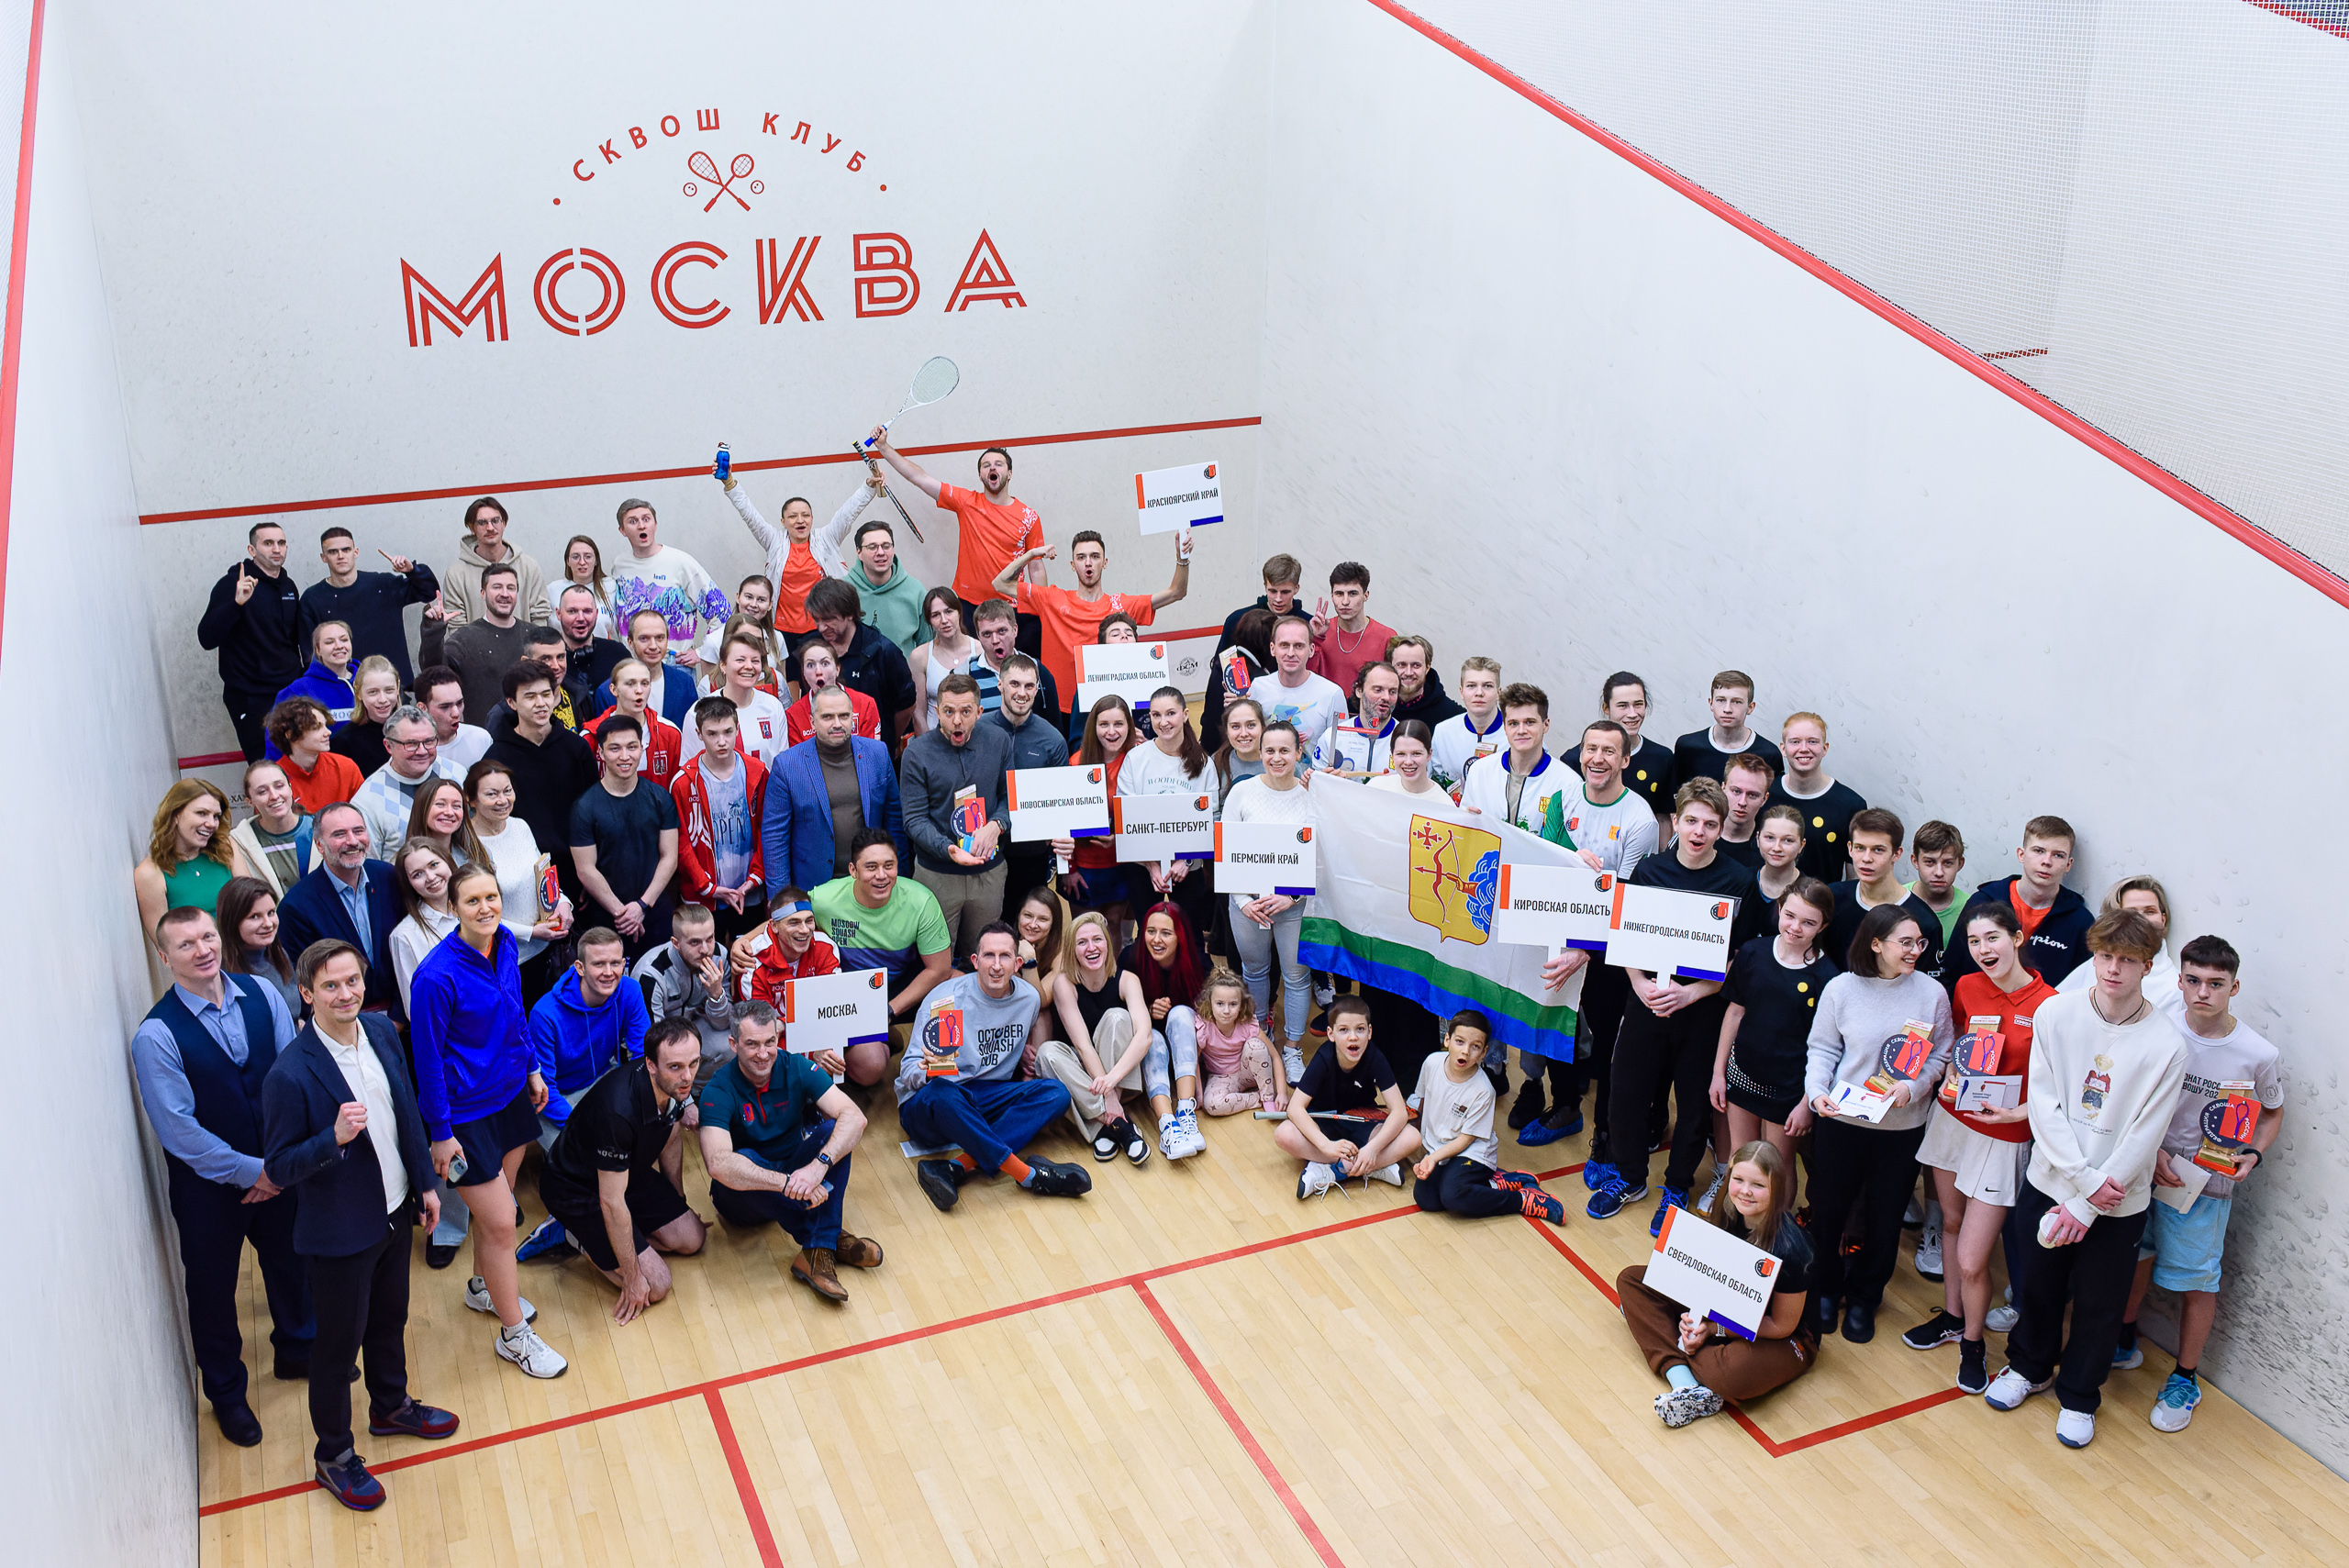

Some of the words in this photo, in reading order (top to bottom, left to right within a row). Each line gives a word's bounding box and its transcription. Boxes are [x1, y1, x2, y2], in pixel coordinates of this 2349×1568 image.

[573, 108, 721, 183] СКВОШ
[762, 111, 867, 174] КЛУБ
[400, 228, 1029, 348] МОСКВА
[1147, 491, 1200, 508] КРАСНОЯРСКИЙ
[1200, 487, 1219, 500] КРАЙ
[1087, 673, 1139, 683] ЛЕНИНГРАДСКАЯ
[1139, 671, 1166, 681] ОБЛАСТЬ
[1148, 776, 1192, 791] WOODFORD
[1019, 797, 1074, 809] НОВОСИБИРСКАЯ
[1075, 796, 1104, 806] ОБЛАСТЬ
[1126, 820, 1209, 834] САНКТ-ПЕТЕРБУРГ
[1231, 852, 1275, 863] ПЕРМСКИЙ
[1277, 853, 1299, 864] КРАЙ
[1514, 899, 1567, 913] КИРОВСКАЯ
[1570, 903, 1611, 916] ОБЛАСТЬ
[831, 918, 860, 930] MOSCOW
[831, 927, 856, 938] SQUASH
[1623, 920, 1689, 940] НИЖЕГОРОДСКАЯ
[1691, 930, 1725, 945] ОБЛАСТЬ
[818, 1003, 858, 1019] МОСКВА
[977, 1024, 1024, 1043] OCTOBER
[1891, 1037, 1911, 1045] СКВОША
[1960, 1036, 1982, 1046] СКВОША
[978, 1039, 1015, 1056] SQUASH
[2204, 1089, 2219, 1099] 202
[2209, 1102, 2234, 1112] СКВОША
[2203, 1112, 2221, 1143] ФЕДЕРАЦИЯ
[2239, 1117, 2251, 1140] РОССИИ
[1667, 1246, 1728, 1285] СВЕРДЛОВСКАЯ
[1728, 1278, 1763, 1304] ОБЛАСТЬ
